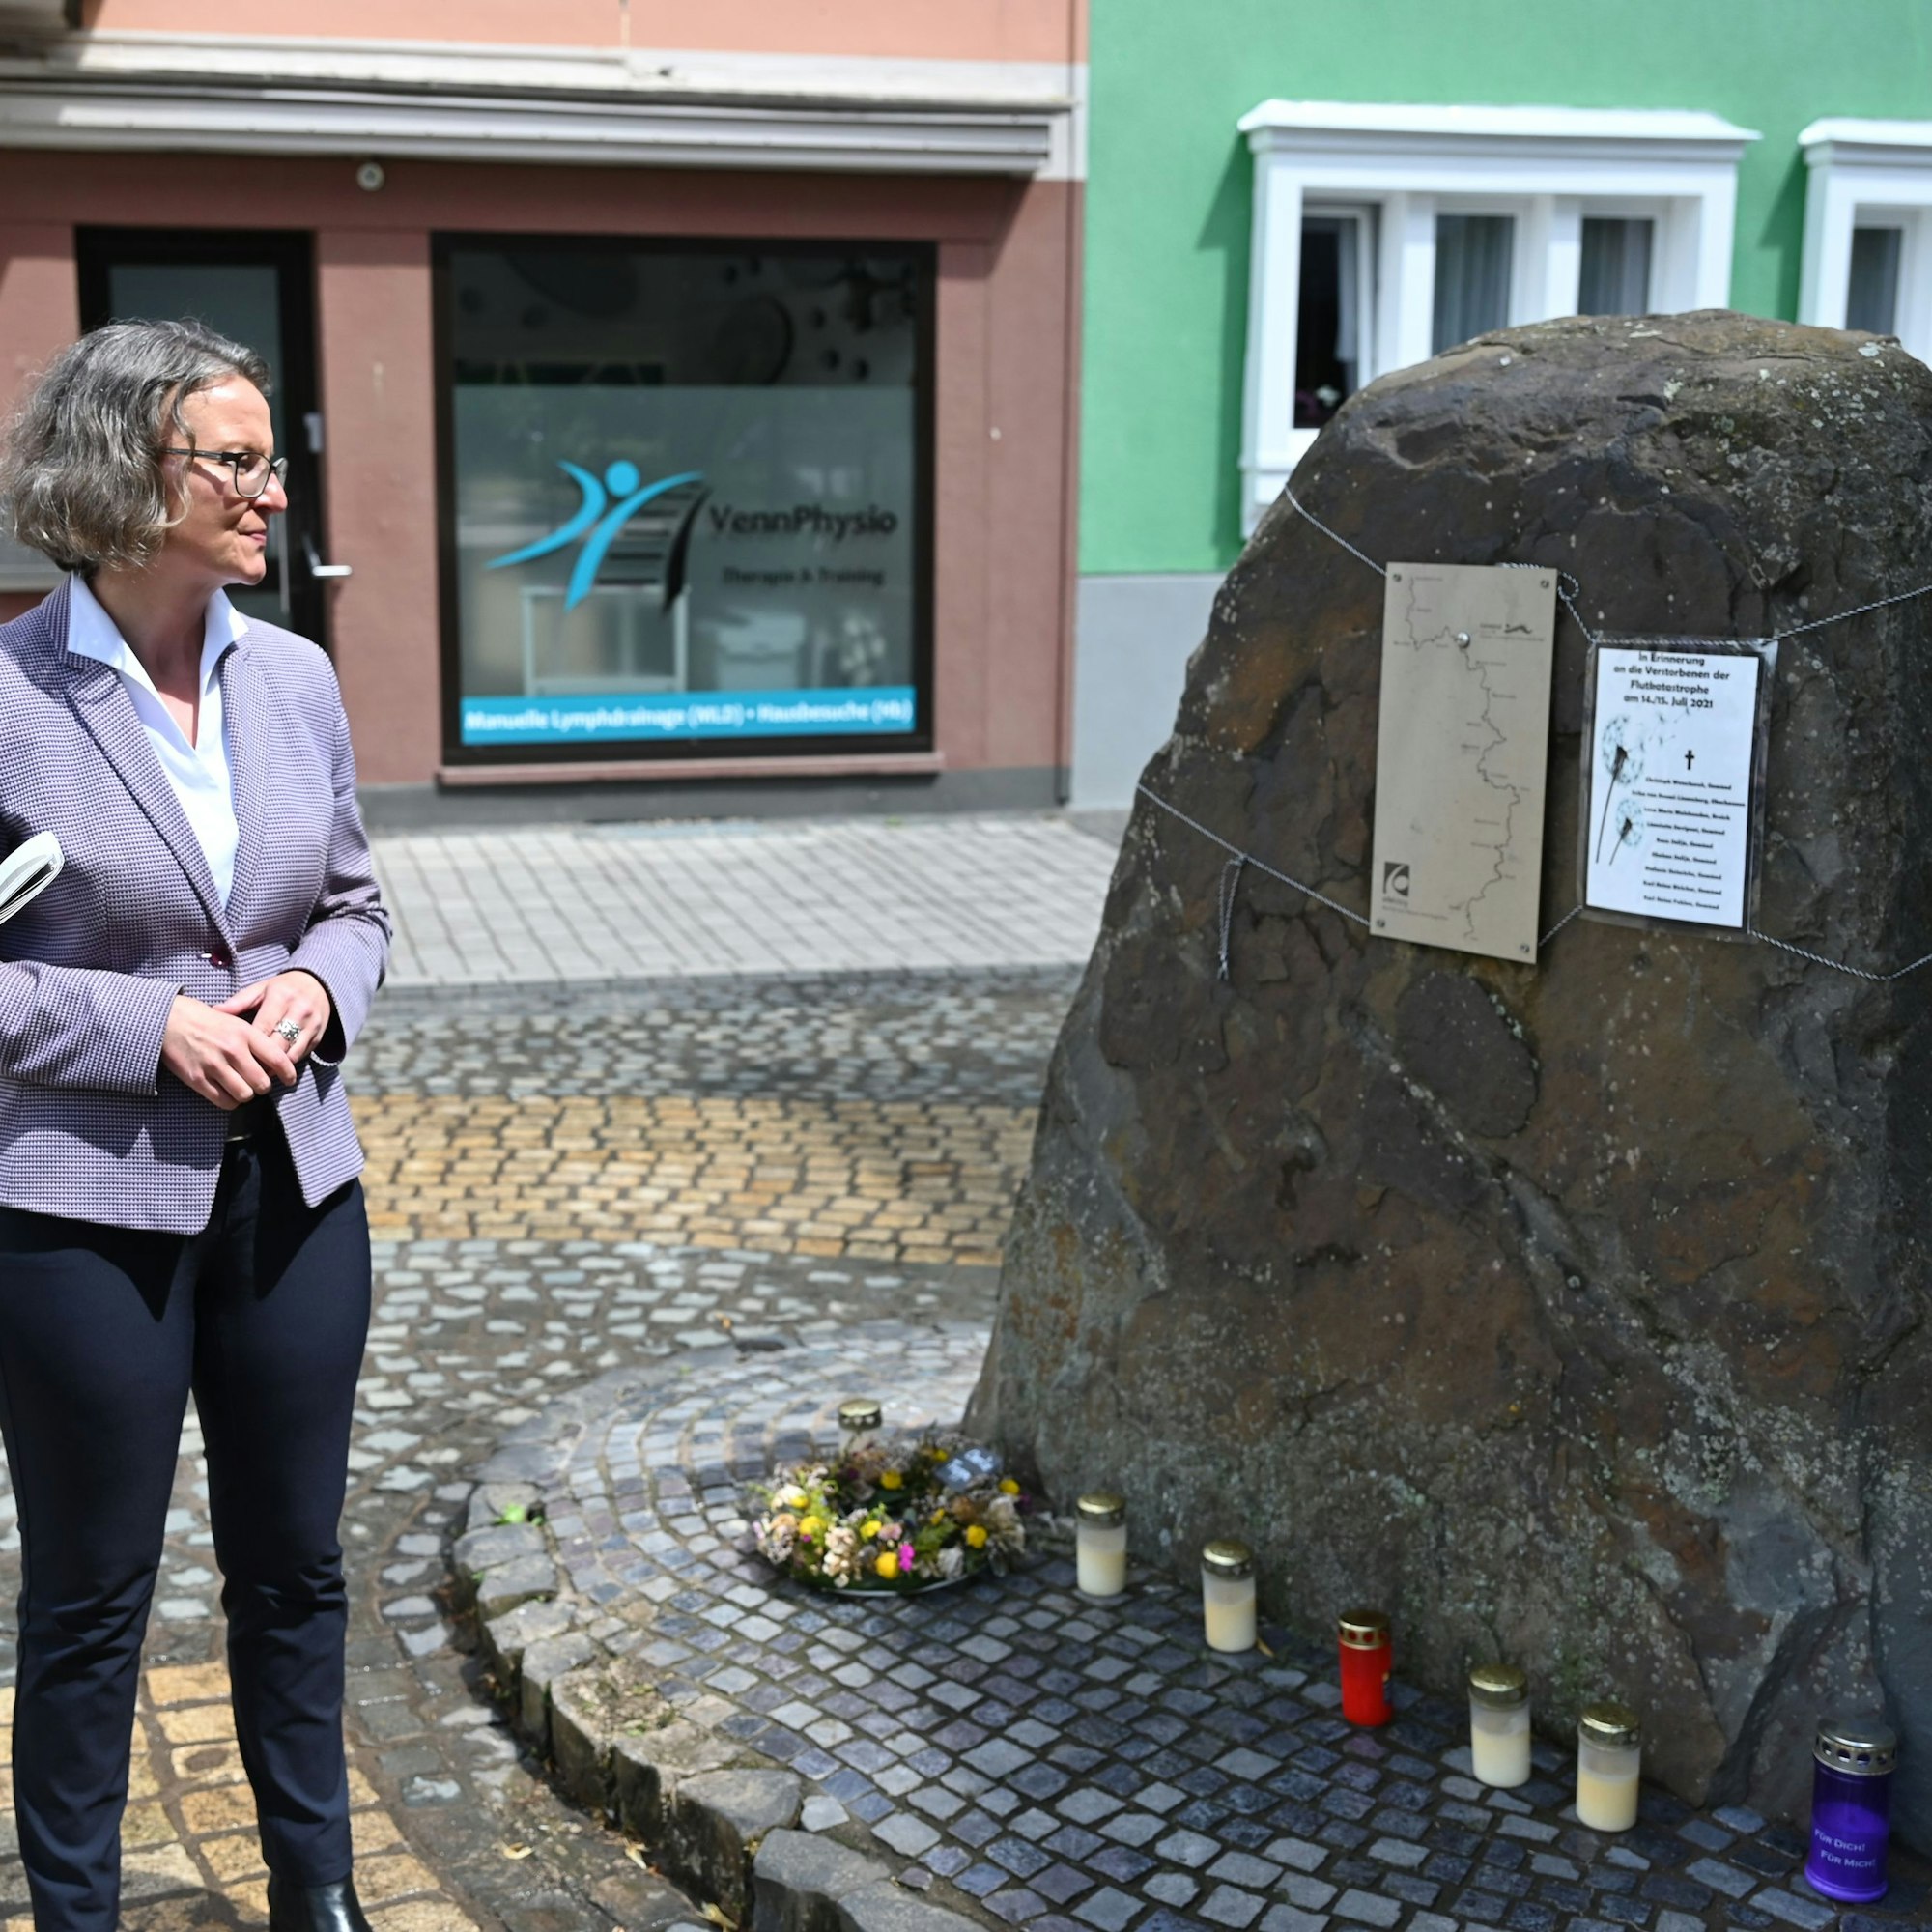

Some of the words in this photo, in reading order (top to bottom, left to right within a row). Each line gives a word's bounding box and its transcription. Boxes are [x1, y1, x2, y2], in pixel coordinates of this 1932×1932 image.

[709, 504, 898, 543] VennPhysio
[1651, 652, 1705, 666] Erinnerung
[1628, 665, 1642, 674] die
[1645, 667, 1710, 679] Verstorbenen
[1713, 670, 1730, 680] der
[1630, 680, 1709, 695] Flutkatastrophe
[1671, 697, 1688, 706] Juli
[1690, 699, 1713, 708] 2021
[465, 709, 548, 730] Manuelle
[551, 706, 686, 733] Lymphdrainage
[756, 700, 869, 724] Hausbesuche
